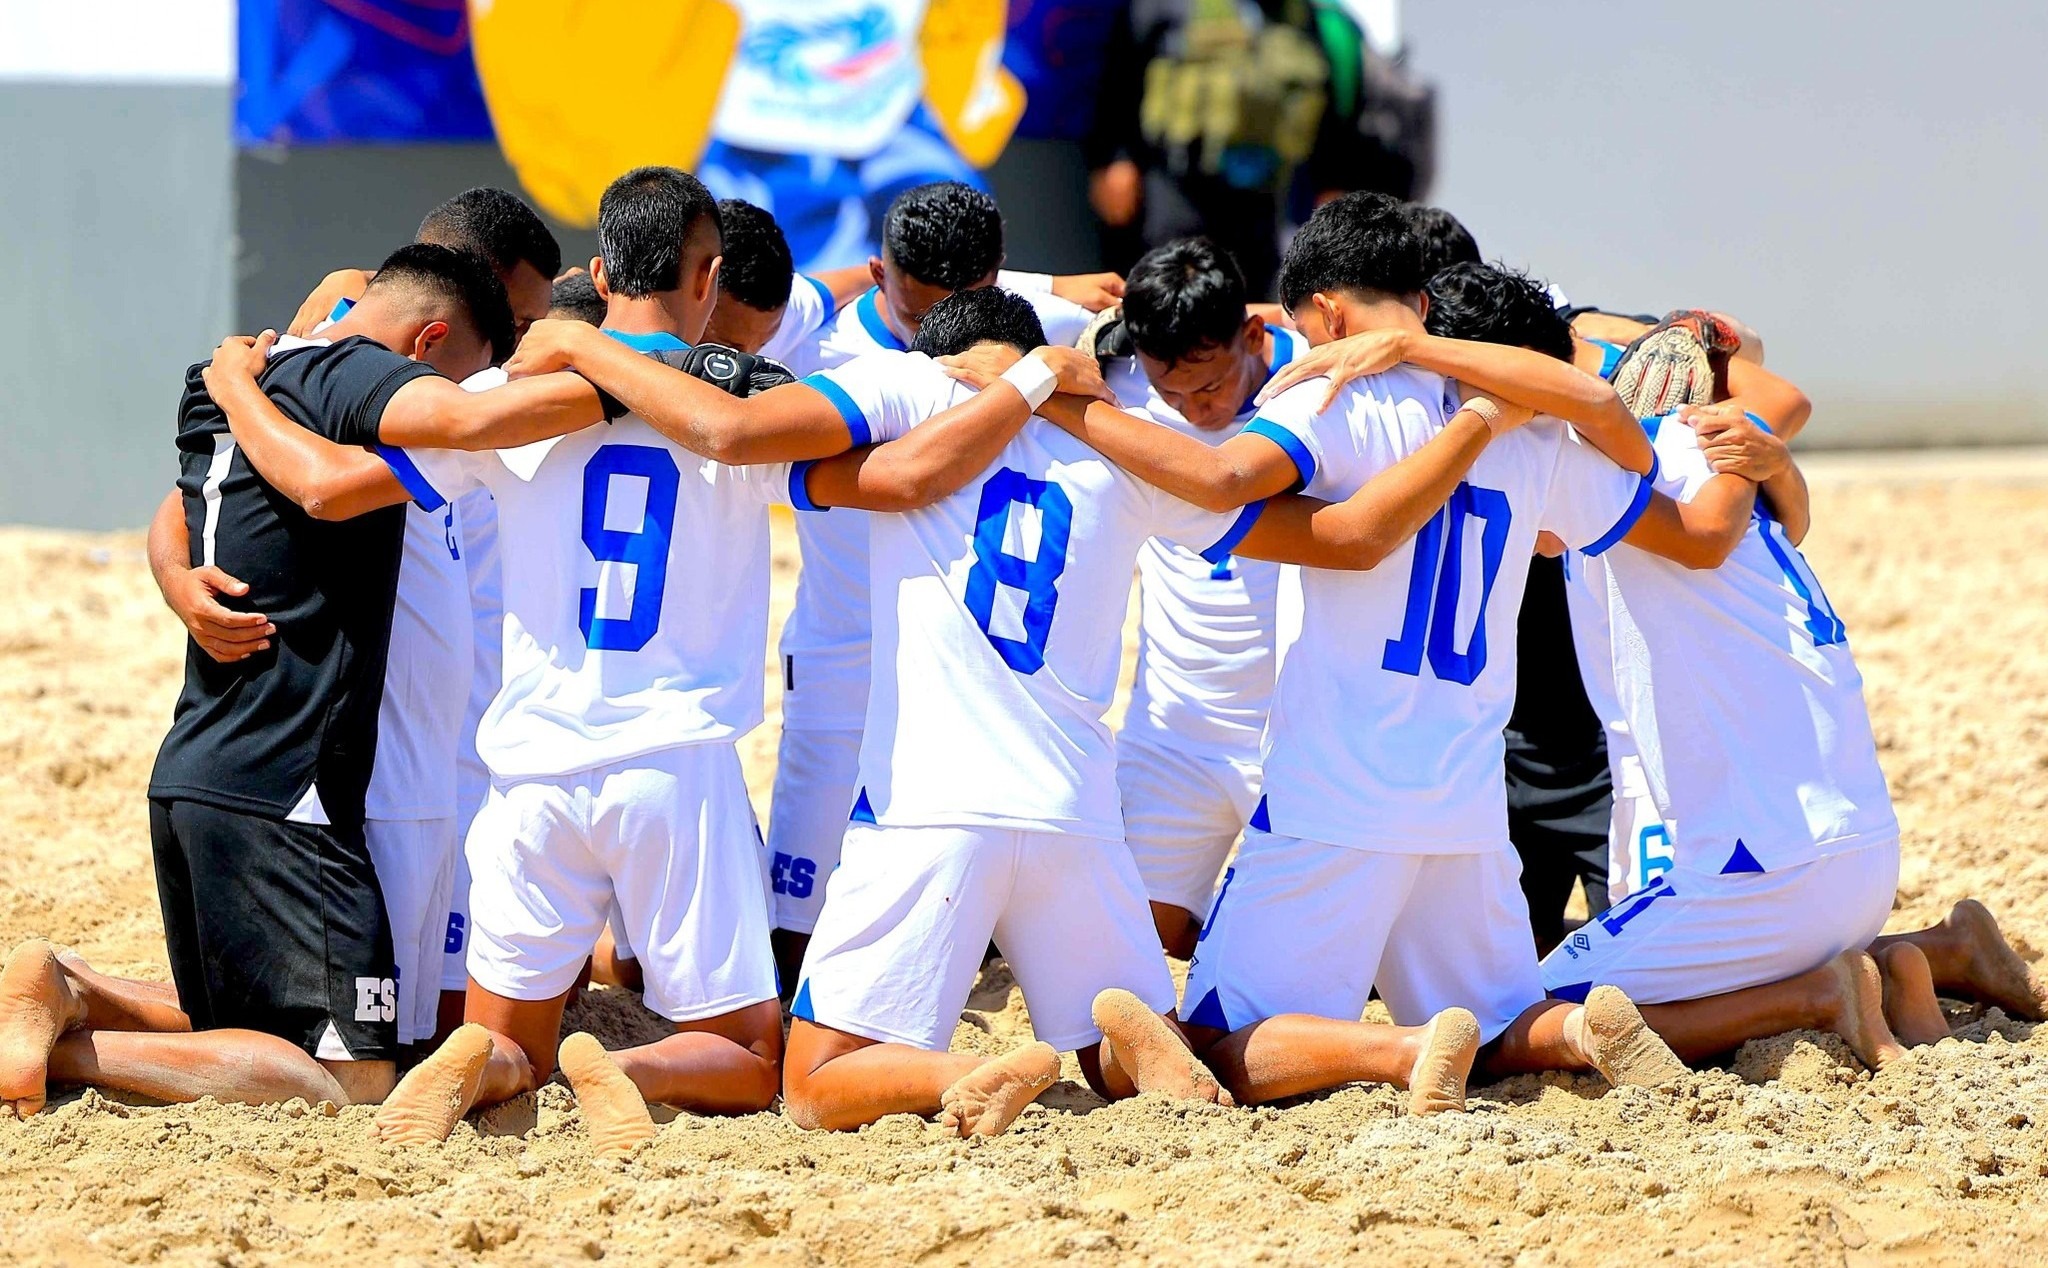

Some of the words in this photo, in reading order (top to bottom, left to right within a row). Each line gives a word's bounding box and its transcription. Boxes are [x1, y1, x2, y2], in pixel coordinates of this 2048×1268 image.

[578, 444, 680, 652] 9
[964, 466, 1073, 675] 8
[1382, 481, 1513, 686] 10
[771, 851, 817, 899] ES
[355, 977, 396, 1022] ES
